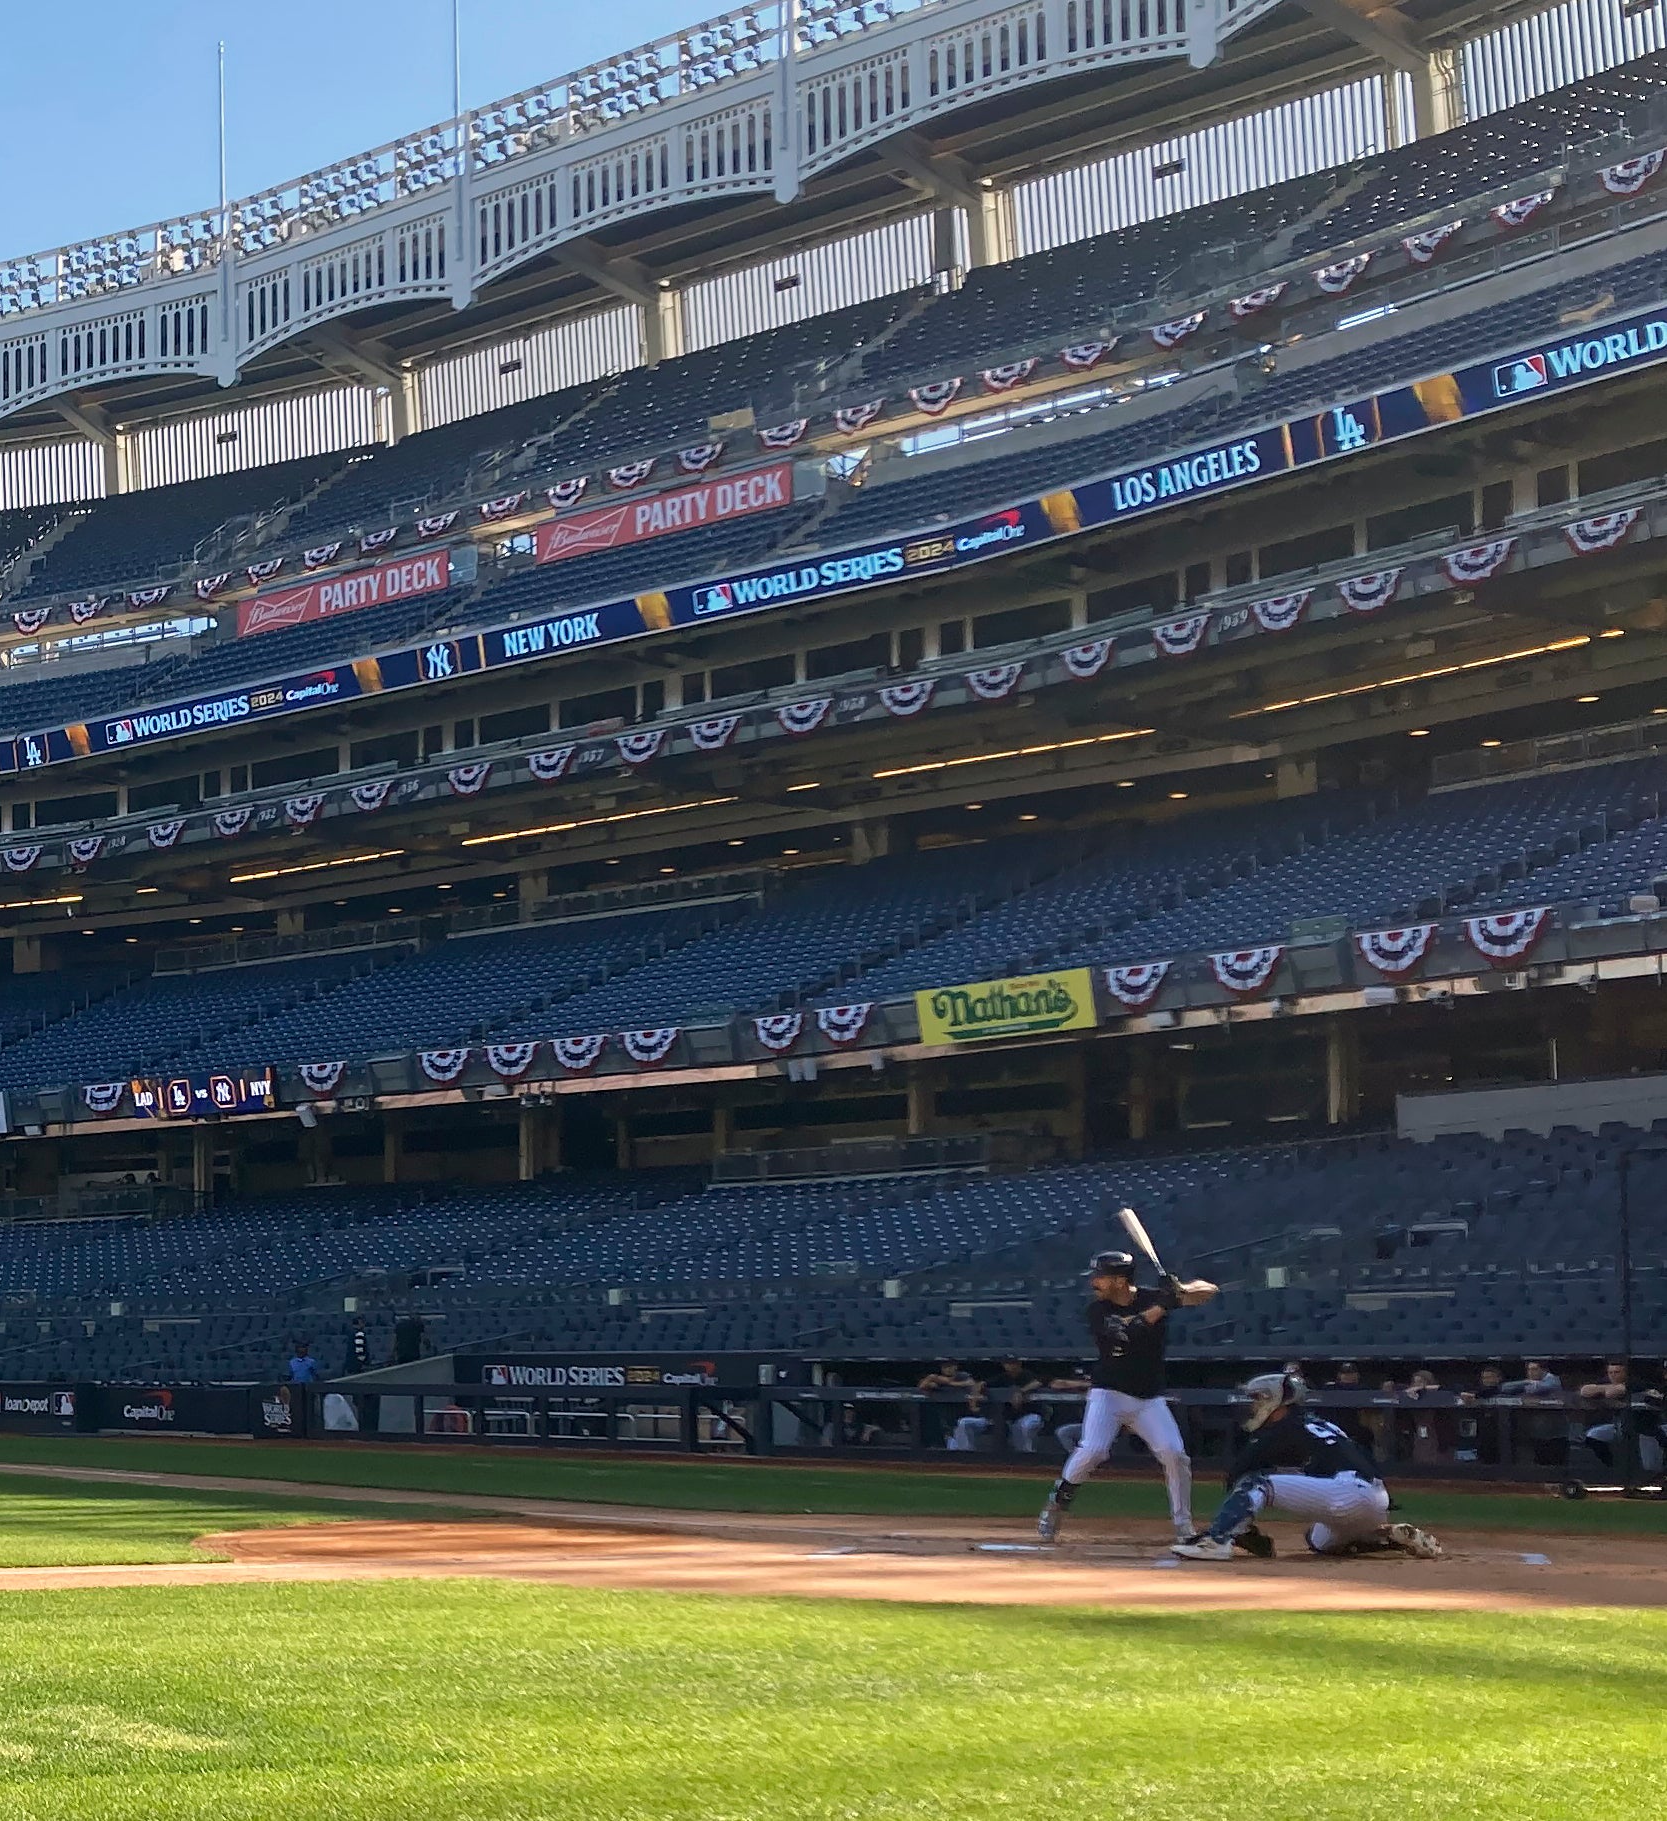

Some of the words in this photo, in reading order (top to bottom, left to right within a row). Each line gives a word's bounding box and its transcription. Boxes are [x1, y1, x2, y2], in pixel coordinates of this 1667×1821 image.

[1547, 321, 1667, 378] WORLD
[1333, 407, 1368, 451] LA
[1111, 472, 1156, 511] LOS
[1158, 440, 1261, 498] ANGELES
[636, 489, 710, 535] PARTY
[716, 470, 783, 515] DECK
[319, 573, 381, 613] PARTY
[385, 557, 442, 597] DECK
[732, 567, 819, 604] WORLD
[820, 547, 904, 586] SERIES
[907, 539, 955, 562] 2024
[503, 626, 548, 657] NEW
[549, 612, 601, 646] YORK
[426, 643, 453, 679] NY
[132, 710, 192, 737] WORLD
[193, 696, 249, 725] SERIES
[250, 691, 283, 708] 2024
[24, 737, 42, 766] LA
[931, 978, 1072, 1026] Nathan's
[134, 1091, 153, 1106] LAD
[216, 1082, 231, 1101] NY
[250, 1080, 271, 1096] NYY
[508, 1366, 566, 1385] WORLD
[567, 1366, 625, 1386] SERIES
[5, 1396, 49, 1415] loanDepot
